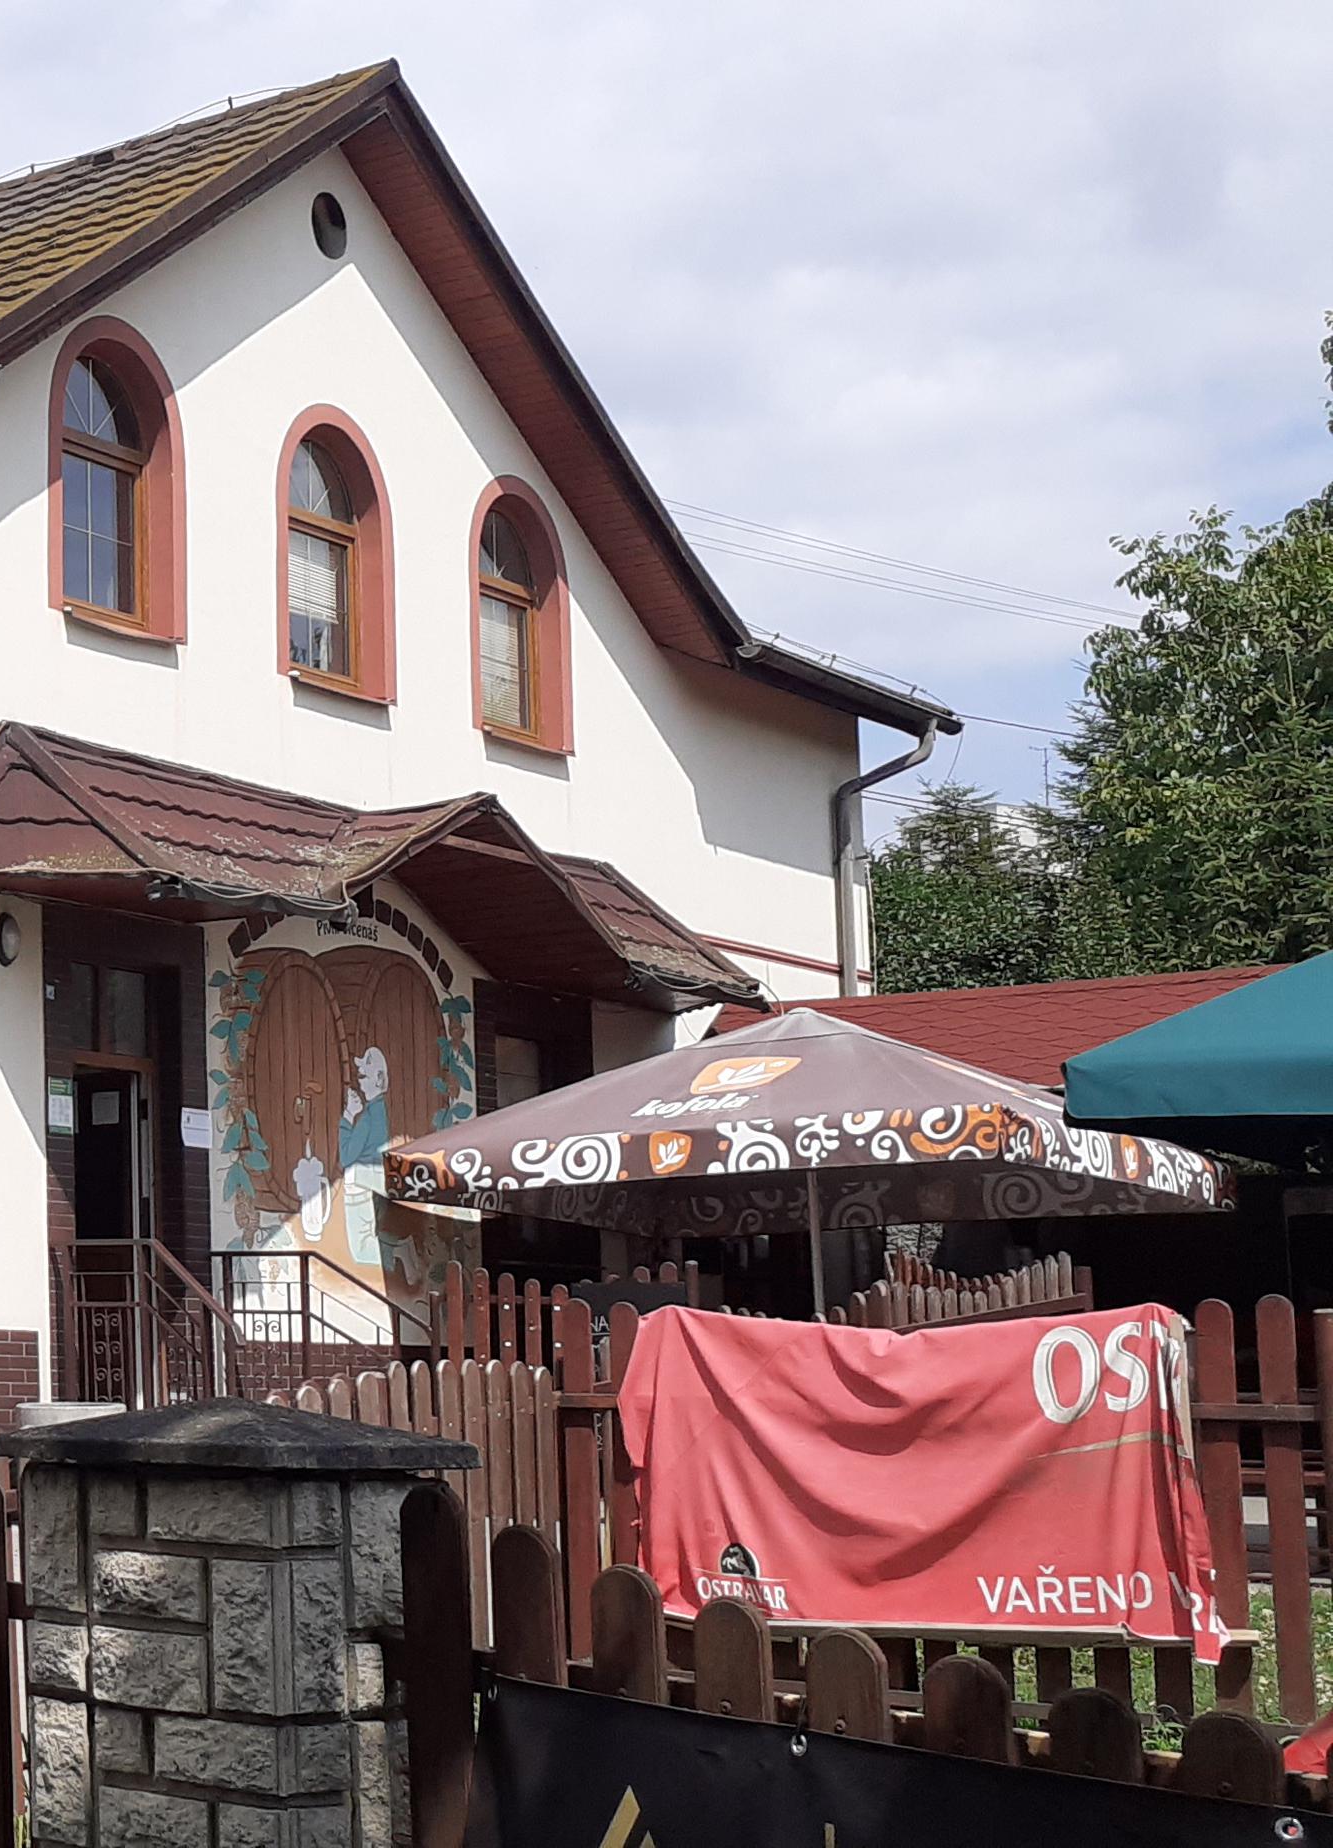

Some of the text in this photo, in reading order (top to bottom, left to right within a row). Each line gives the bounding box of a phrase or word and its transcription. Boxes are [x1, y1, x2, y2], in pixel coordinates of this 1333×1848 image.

[631, 1092, 752, 1118] kofola
[696, 1576, 789, 1611] OSTRAVAR
[976, 1564, 1153, 1614] VAŘENO
